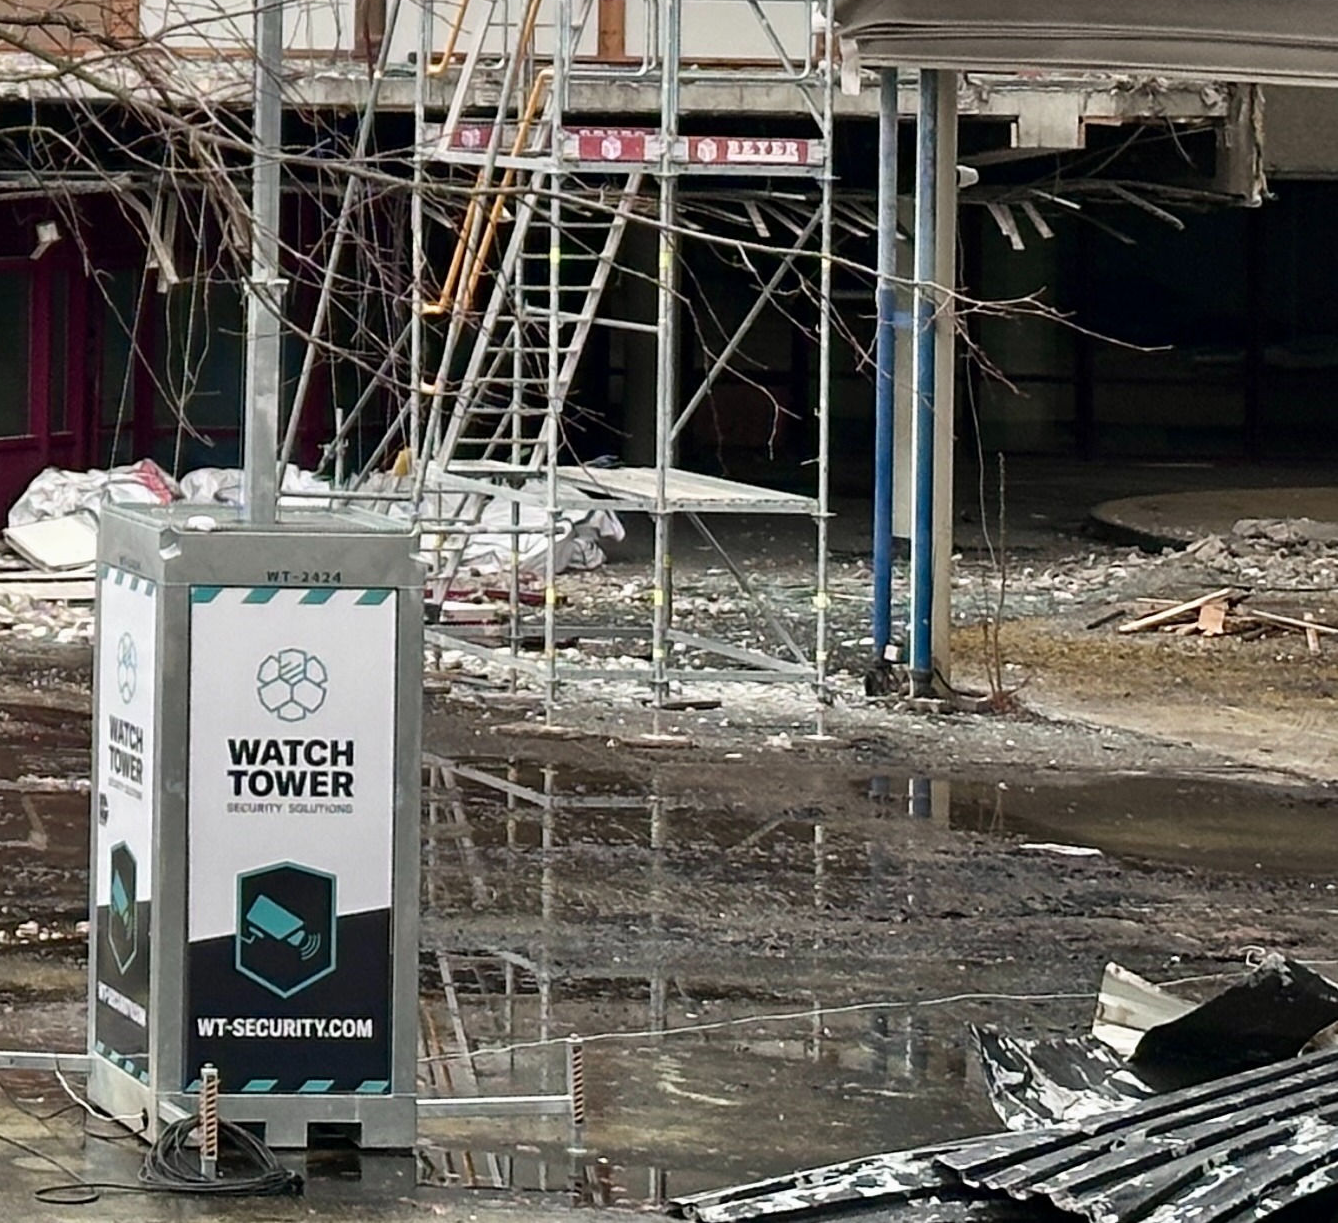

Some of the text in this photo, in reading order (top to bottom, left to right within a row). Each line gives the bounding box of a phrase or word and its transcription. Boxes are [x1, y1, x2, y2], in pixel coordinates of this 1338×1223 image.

[726, 140, 799, 156] BEYER
[266, 570, 342, 583] WT-2424
[109, 713, 143, 754] WATCH
[108, 744, 143, 785] TOWER
[227, 738, 355, 767] WATCH
[227, 769, 355, 798] TOWER
[226, 802, 354, 815] SECURITY SOLUTIONS
[197, 1017, 374, 1039] WT-SECURITY.COM
